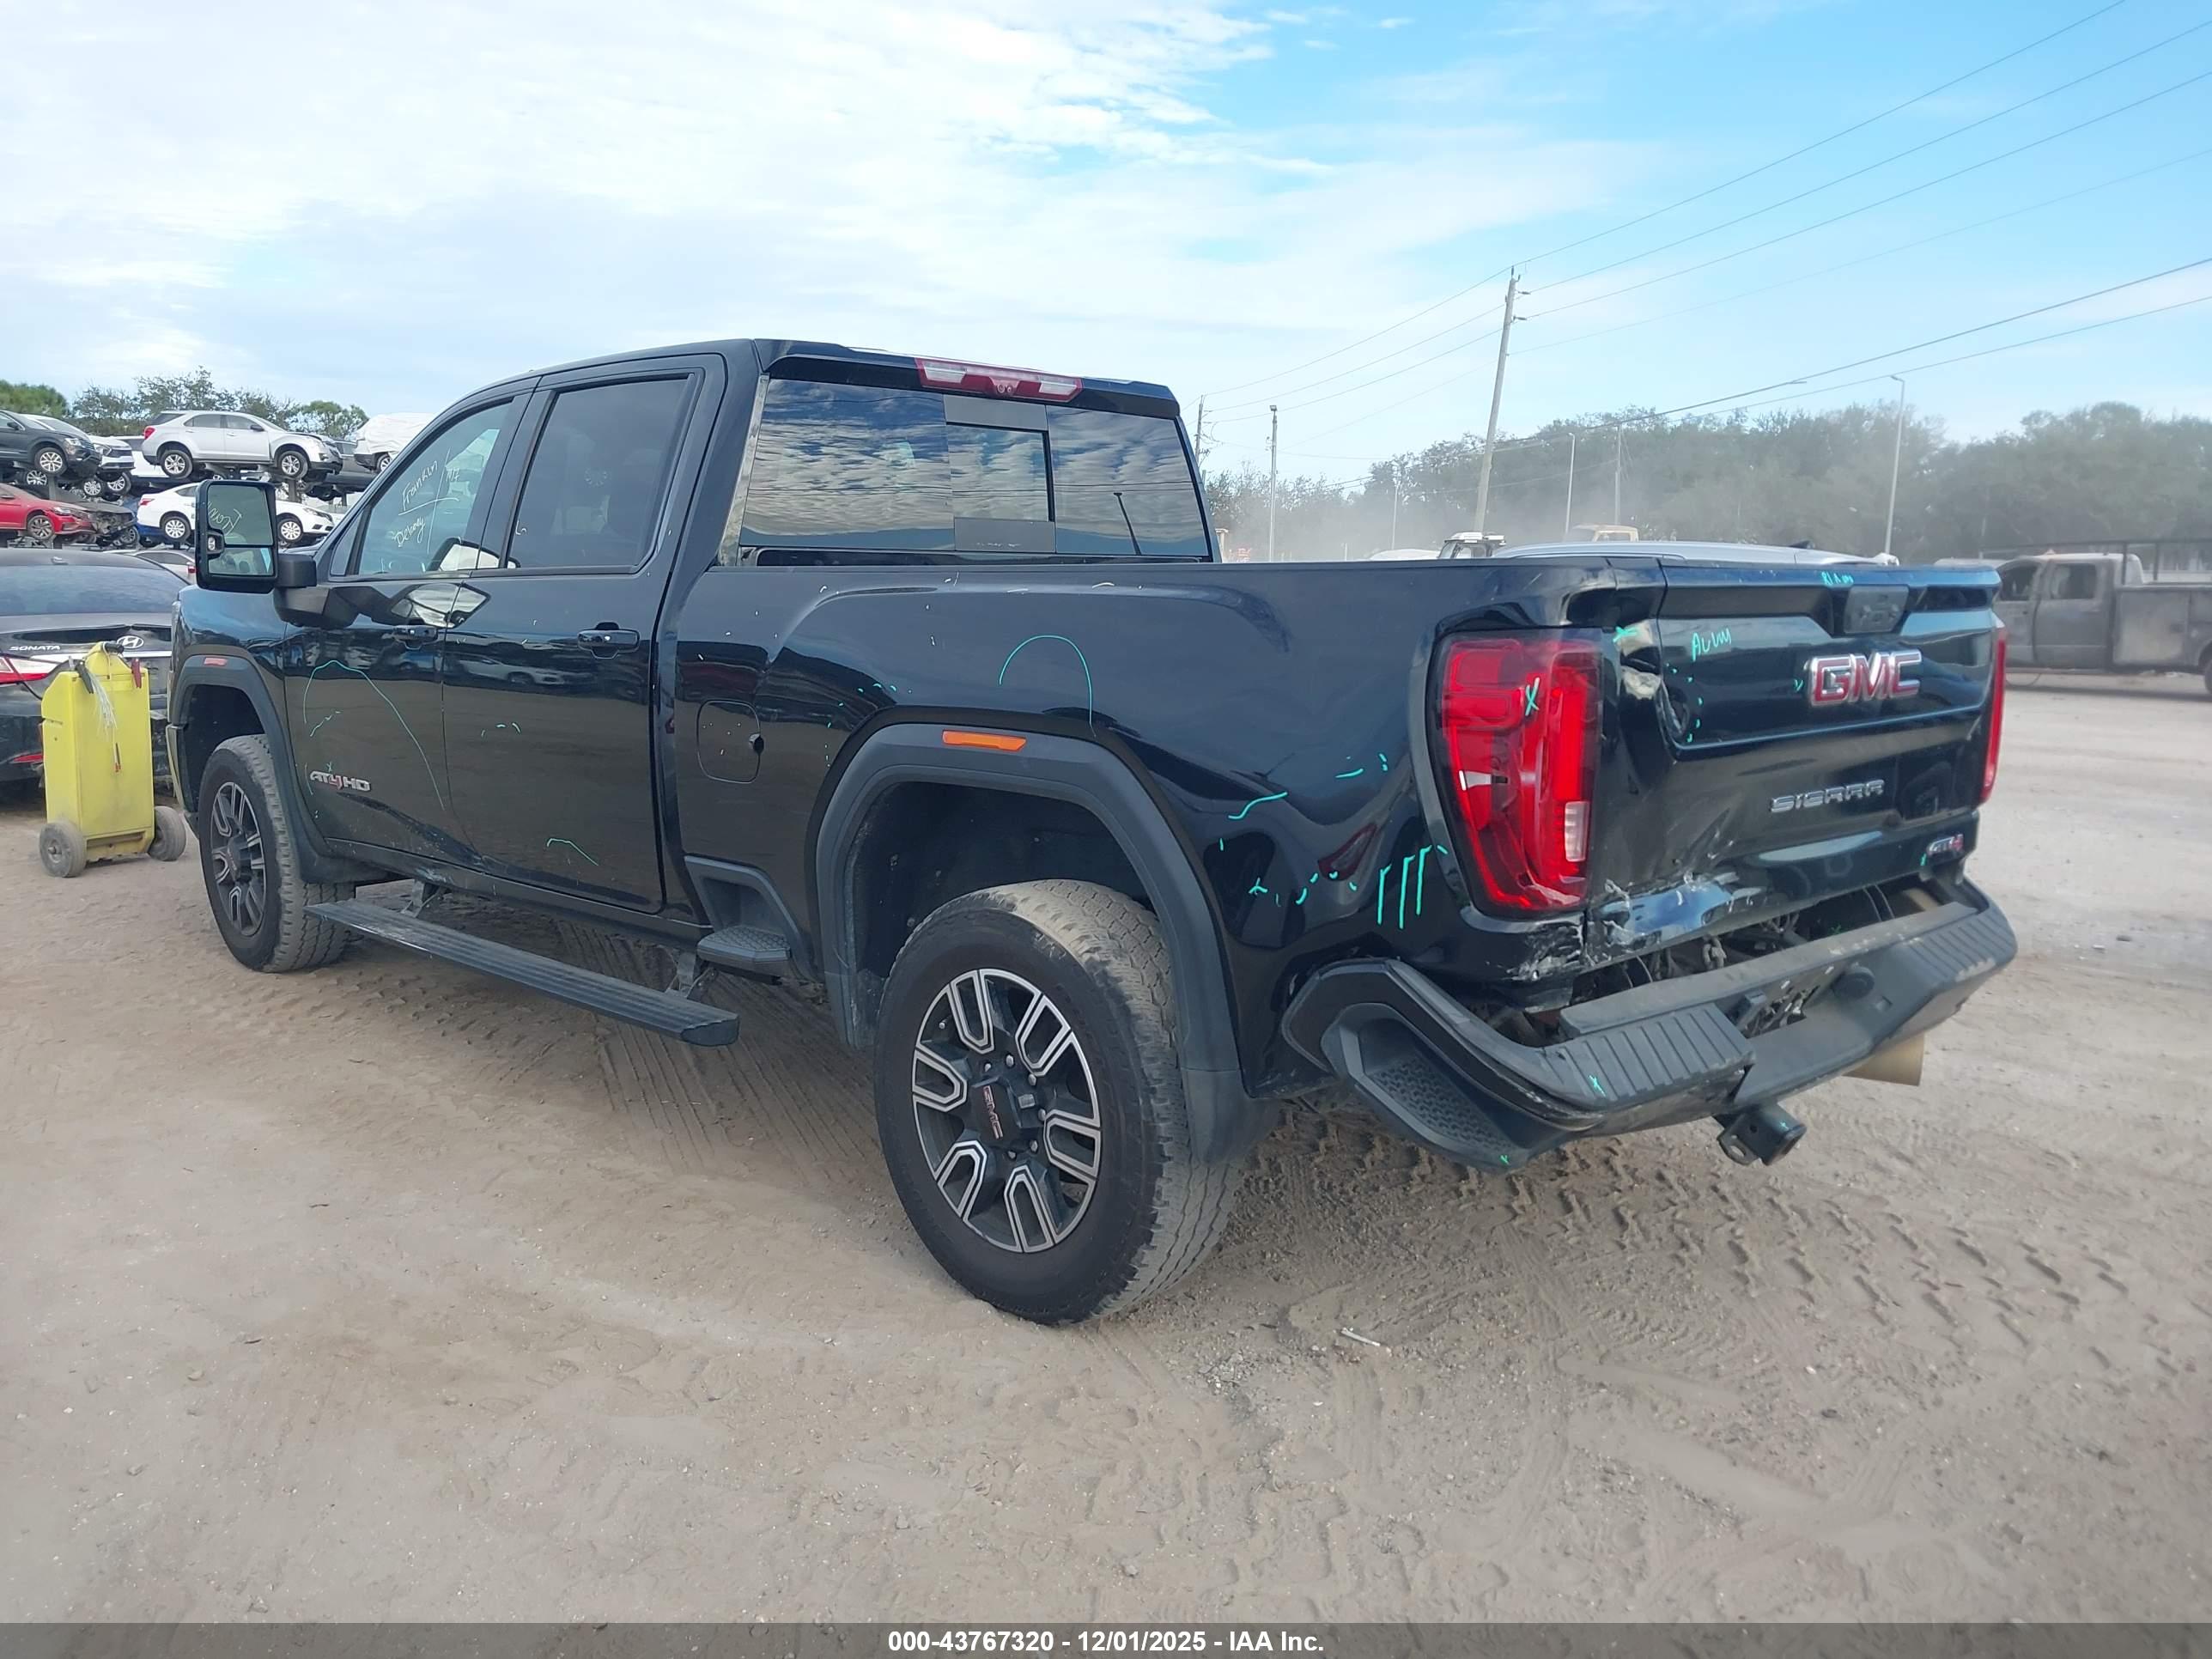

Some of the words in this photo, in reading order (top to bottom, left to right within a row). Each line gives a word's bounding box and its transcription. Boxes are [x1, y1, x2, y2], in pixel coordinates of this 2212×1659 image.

[1809, 649, 1922, 706] GMC
[1771, 779, 1885, 812] SIERRA
[983, 1085, 1004, 1139] GMC
